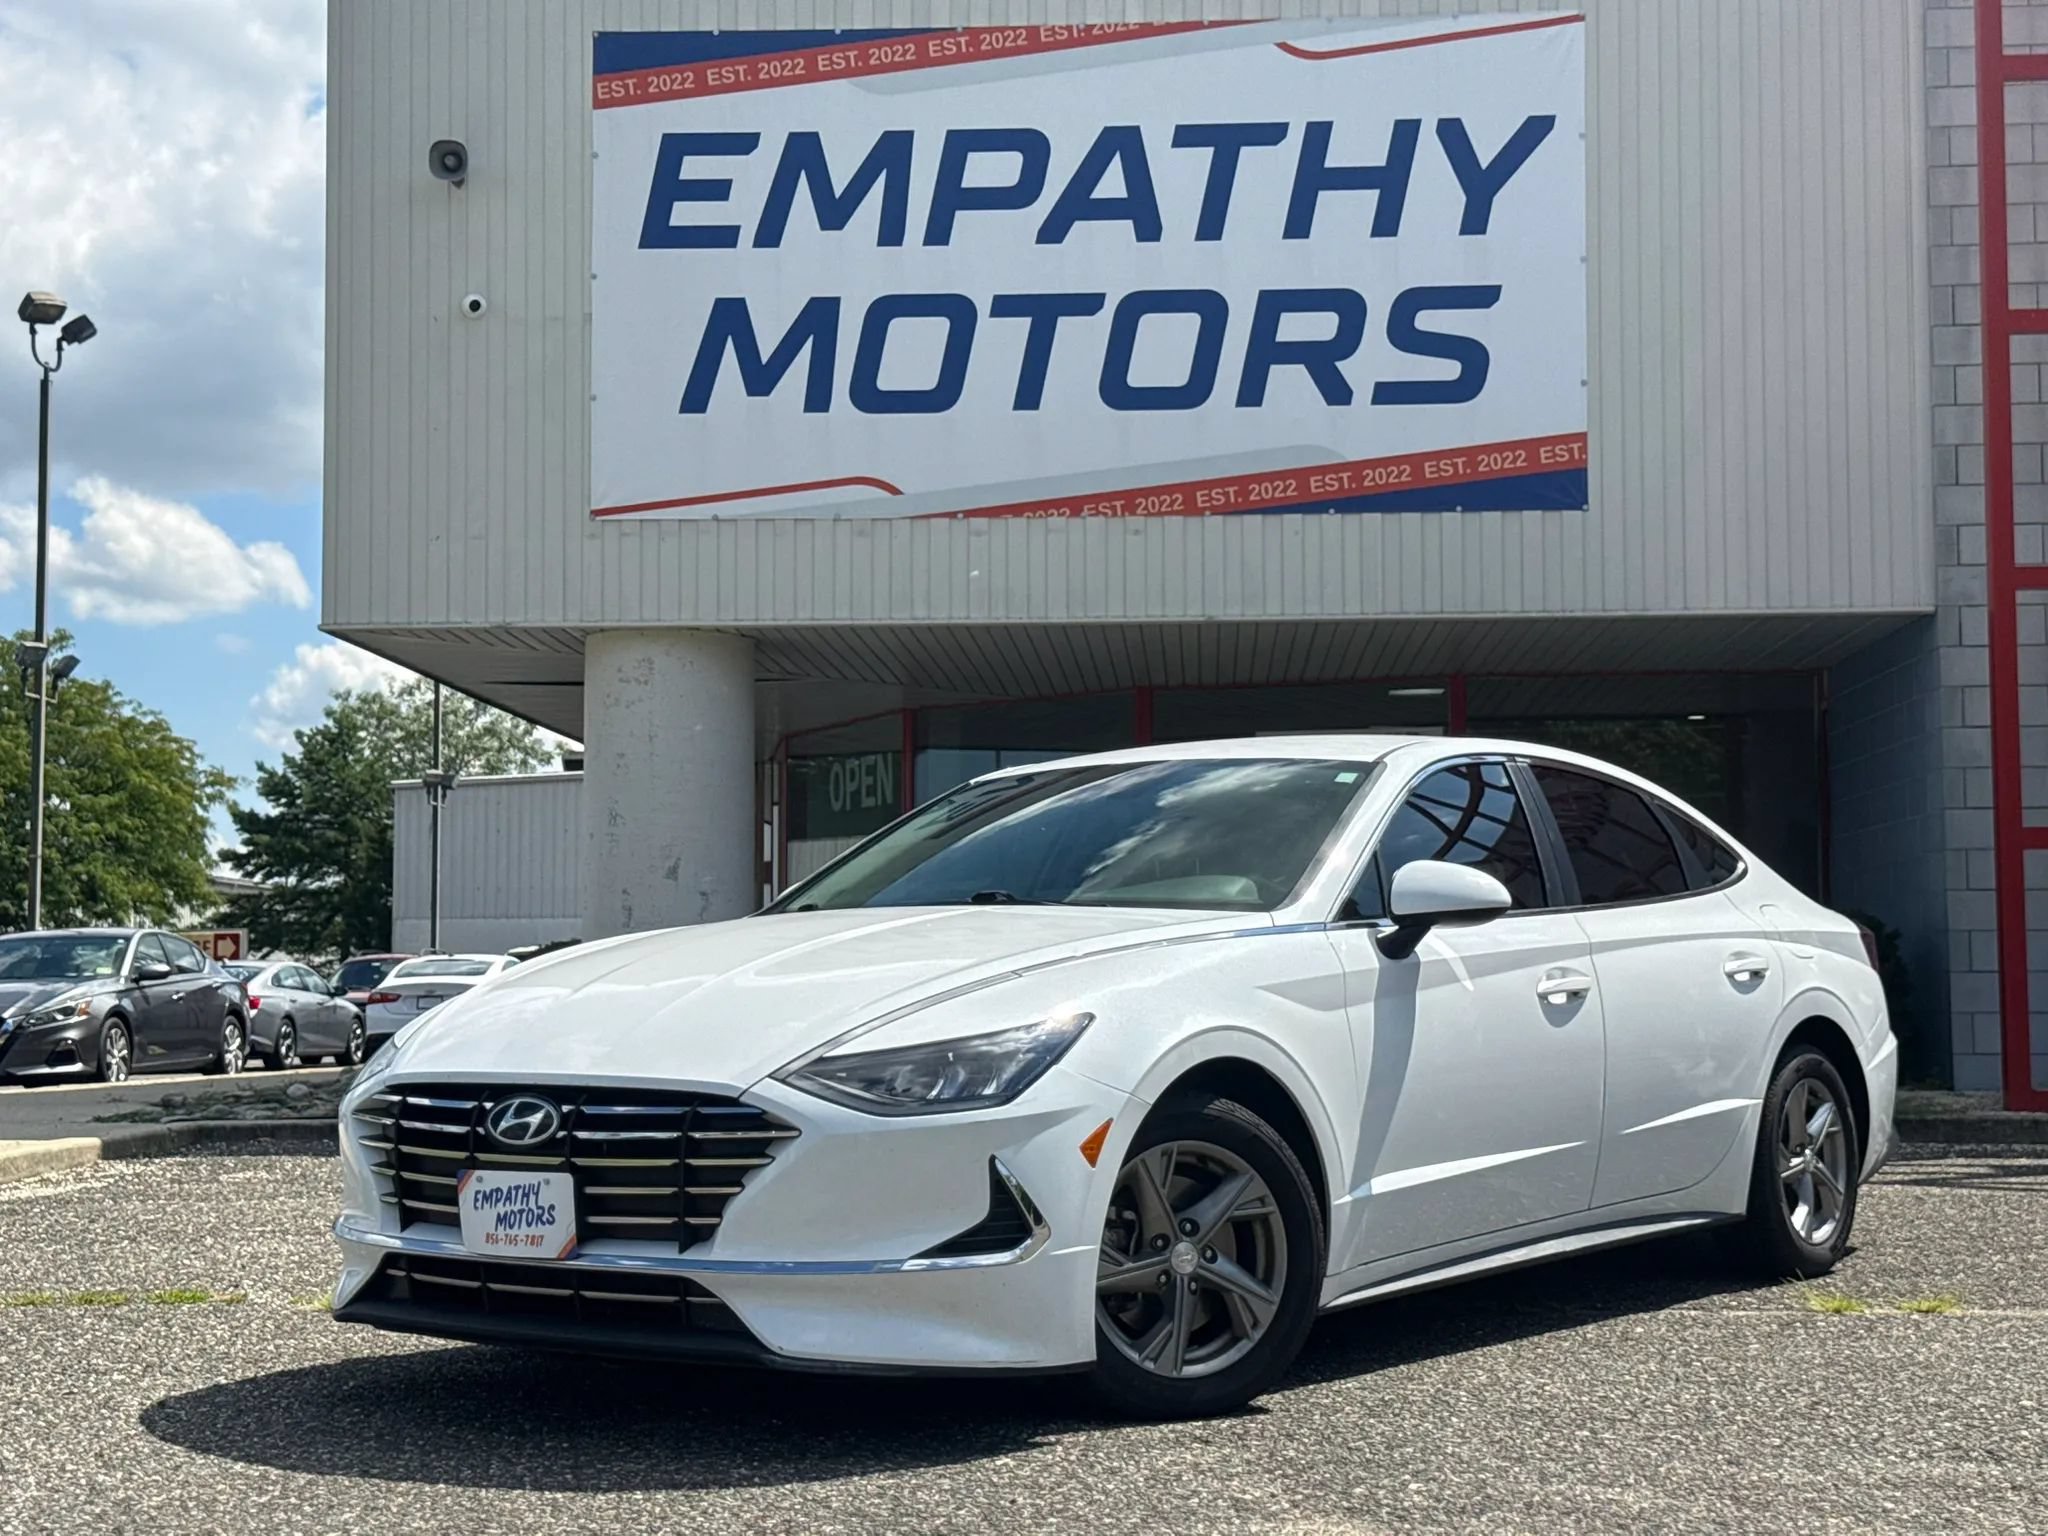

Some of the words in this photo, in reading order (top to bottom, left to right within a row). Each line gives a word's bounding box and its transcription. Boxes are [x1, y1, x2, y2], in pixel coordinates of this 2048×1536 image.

[596, 78, 642, 99] EST.
[647, 72, 695, 93] 2022
[706, 64, 752, 86] EST.
[757, 58, 806, 81] 2022
[817, 50, 863, 72] EST.
[869, 43, 917, 66] 2022
[928, 36, 974, 58] EST.
[980, 28, 1028, 51] 2022
[637, 114, 1557, 249] EMPATHY
[678, 284, 1503, 415] MOTORS
[1135, 493, 1184, 515] 2022
[1196, 485, 1242, 508] EST.
[1248, 479, 1298, 502] 2022
[1309, 472, 1356, 494] EST.
[1362, 464, 1412, 487] 2022
[1424, 457, 1471, 479] EST.
[1477, 450, 1528, 473] 2022
[1539, 442, 1587, 465] EST.
[829, 752, 894, 812] OPEN
[473, 1180, 542, 1211] EMPATHY
[494, 1203, 556, 1232] MOTORS
